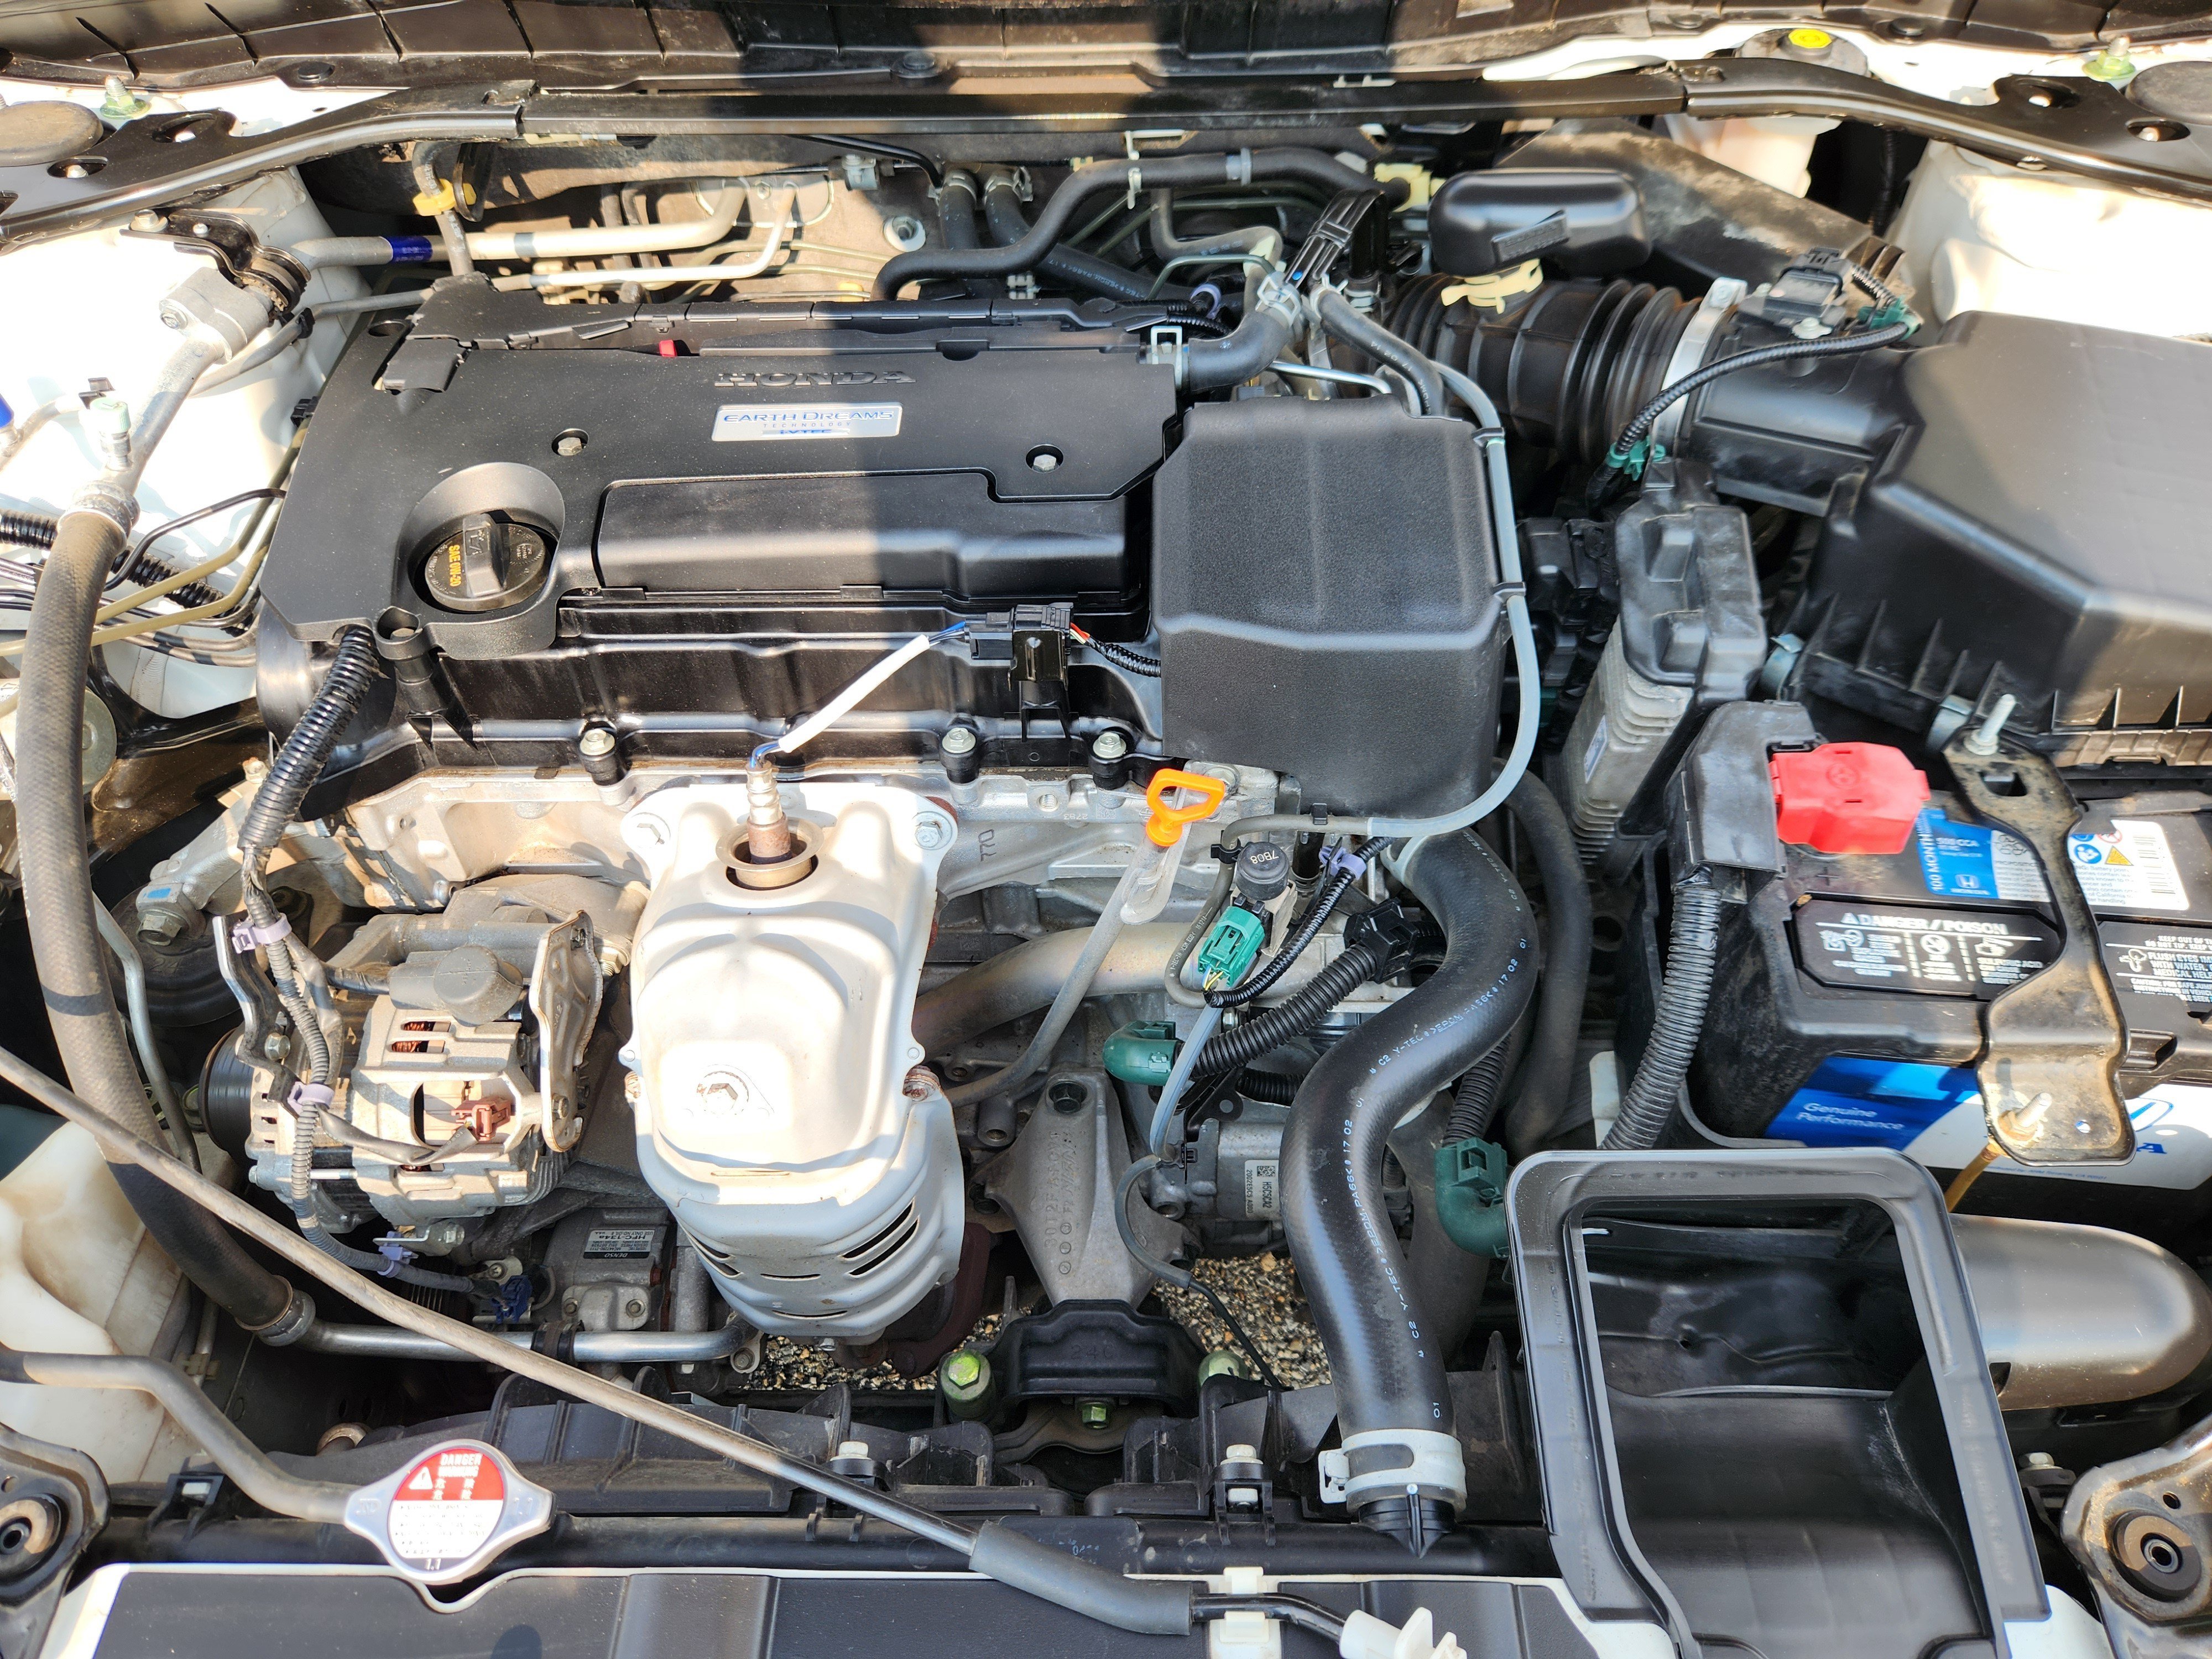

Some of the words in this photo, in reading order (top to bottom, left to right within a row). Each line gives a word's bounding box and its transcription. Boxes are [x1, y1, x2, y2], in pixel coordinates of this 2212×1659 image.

[714, 371, 916, 387] HONDA
[723, 413, 797, 422] EARTH
[802, 411, 894, 421] DREAMS
[448, 544, 461, 562] SAE
[449, 562, 462, 587] 0W-20
[1250, 849, 1280, 864] 7B08
[1928, 874, 1945, 891] 100
[2147, 952, 2176, 961] FLUSH
[2176, 953, 2199, 963] EYES
[2150, 960, 2174, 969] WITH
[2174, 962, 2209, 972] WATER.
[2153, 968, 2192, 978] MEDICAL
[1378, 1055, 1392, 1066] C2
[1392, 1035, 1423, 1055] Y-TEC
[1498, 973, 1509, 985] 17
[1803, 1103, 1878, 1118] Genuine
[1343, 1119, 1353, 1136] 02
[1796, 1112, 1905, 1130] Performance
[1343, 1140, 1352, 1154] 17
[1384, 1266, 1409, 1311] Y-TEC
[1408, 1320, 1420, 1339] C2
[1432, 1401, 1441, 1418] 01
[440, 1452, 483, 1466] DANGER
[424, 1558, 442, 1571] 1.1
